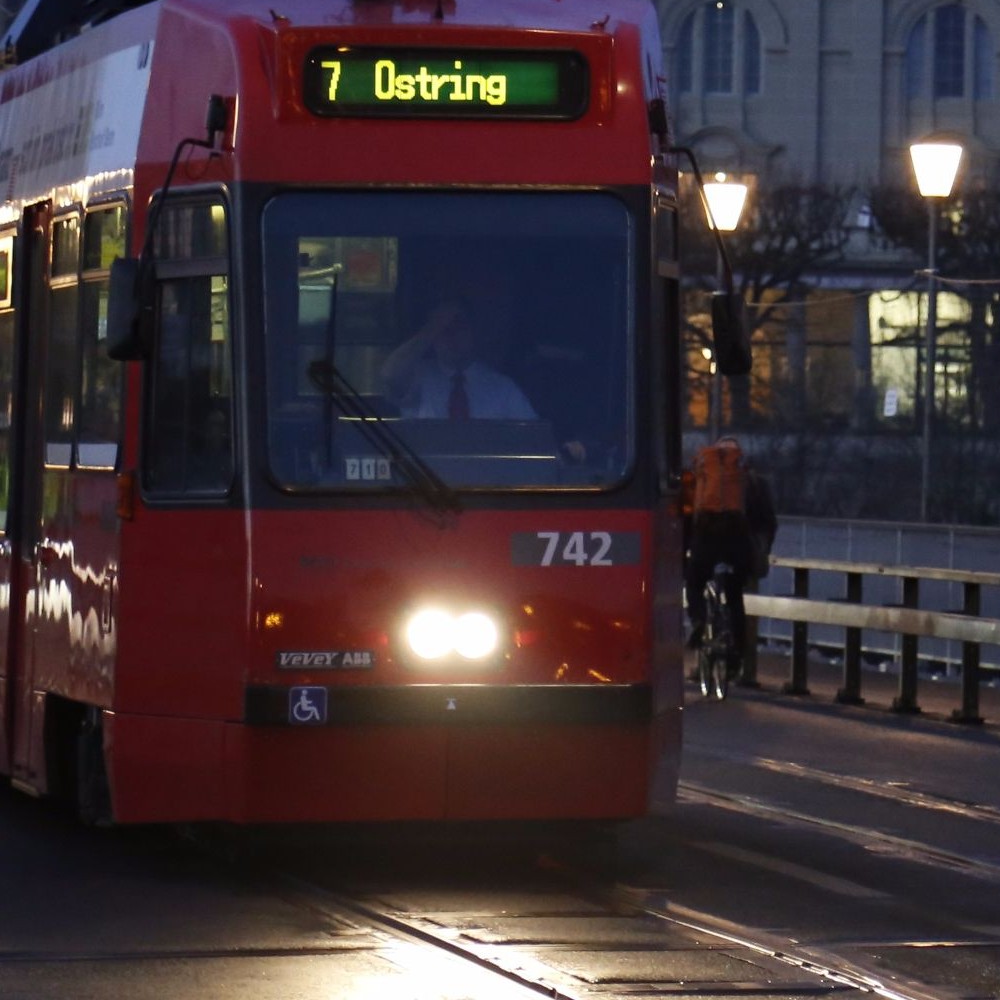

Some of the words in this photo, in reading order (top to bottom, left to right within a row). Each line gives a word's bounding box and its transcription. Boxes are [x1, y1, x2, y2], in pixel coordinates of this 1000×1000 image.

[321, 61, 341, 101] 7
[375, 60, 507, 105] Ostring
[537, 531, 613, 566] 742
[342, 652, 371, 665] ABB
